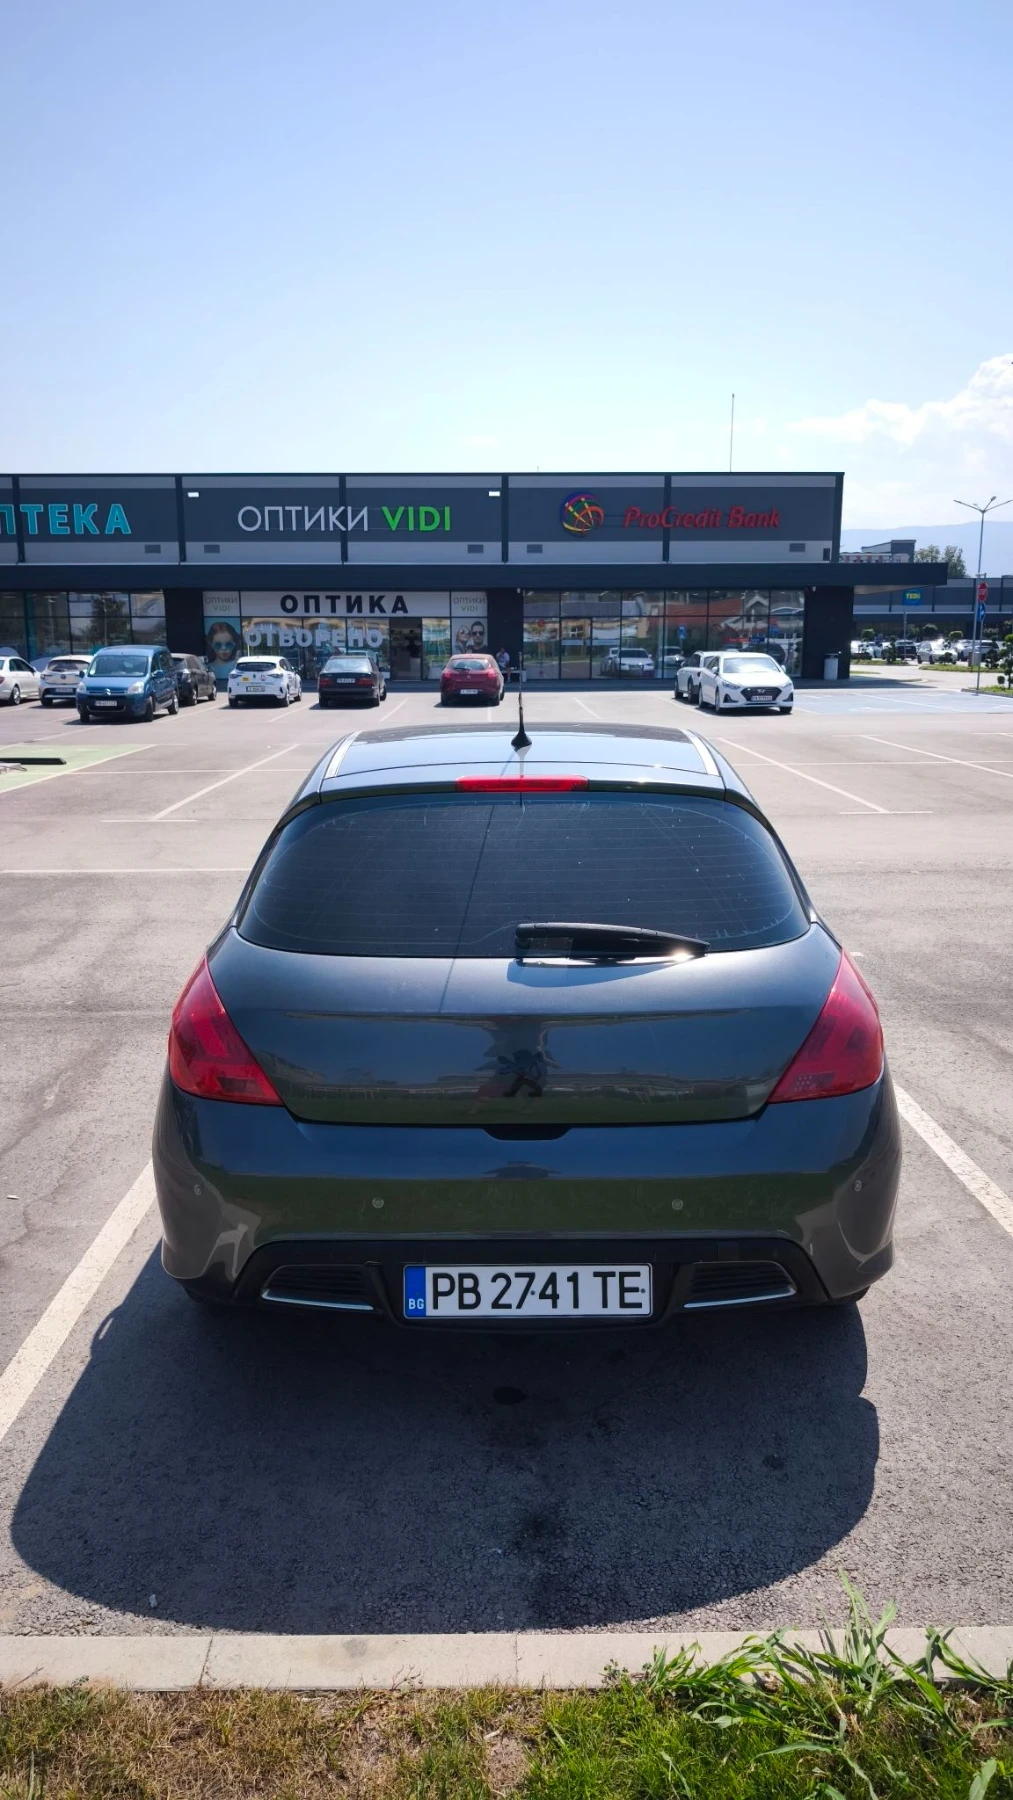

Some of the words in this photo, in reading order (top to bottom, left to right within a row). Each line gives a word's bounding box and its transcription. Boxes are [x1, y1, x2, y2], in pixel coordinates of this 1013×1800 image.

[237, 505, 368, 532] ОПТИКИ
[382, 505, 451, 532] VIDI
[623, 506, 722, 529] ProCredit
[728, 505, 780, 529] Bank
[280, 594, 409, 614] ОПТИКА
[453, 596, 486, 604] ОПТИКИ
[461, 604, 479, 612] VIDI
[245, 628, 383, 648] ОТВОРЕНО
[432, 1272, 482, 1310] PB
[490, 1271, 580, 1310] 2741
[592, 1271, 643, 1309] TE
[408, 1298, 425, 1310] BG
